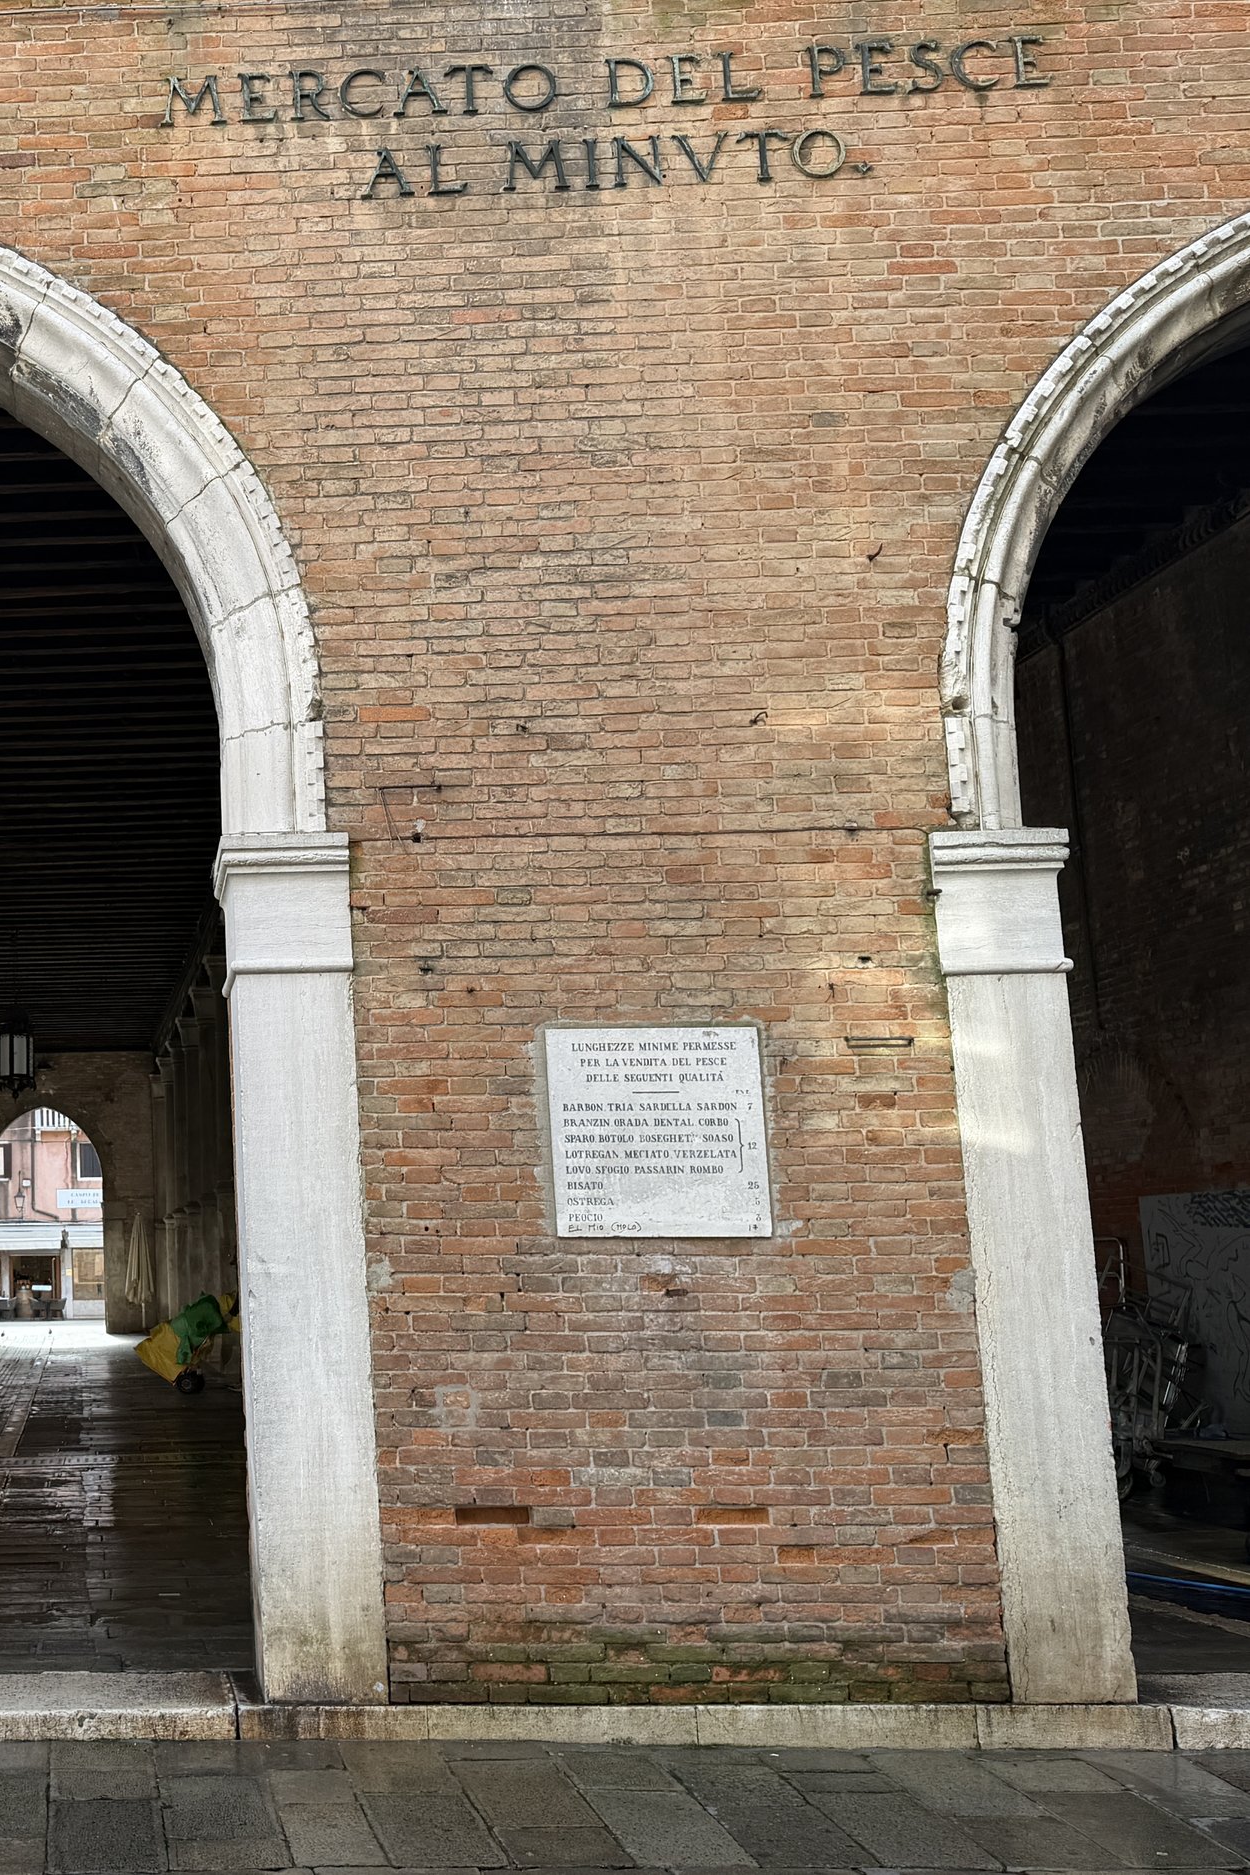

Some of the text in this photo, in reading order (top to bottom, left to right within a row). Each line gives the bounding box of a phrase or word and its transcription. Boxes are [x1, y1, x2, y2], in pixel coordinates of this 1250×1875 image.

[160, 34, 1052, 128] MERCATO DEL PESCE
[360, 144, 468, 200] AL
[571, 1041, 737, 1051] LUNGHEZZE MINIME PERMESSE
[580, 1057, 727, 1067] PER LA VENDITA DEL PESCE
[586, 1074, 619, 1083] DELLE
[624, 1073, 673, 1082] SEGUENTI
[747, 1103, 753, 1111] 7
[747, 1142, 757, 1150] 12
[747, 1181, 760, 1190] 25
